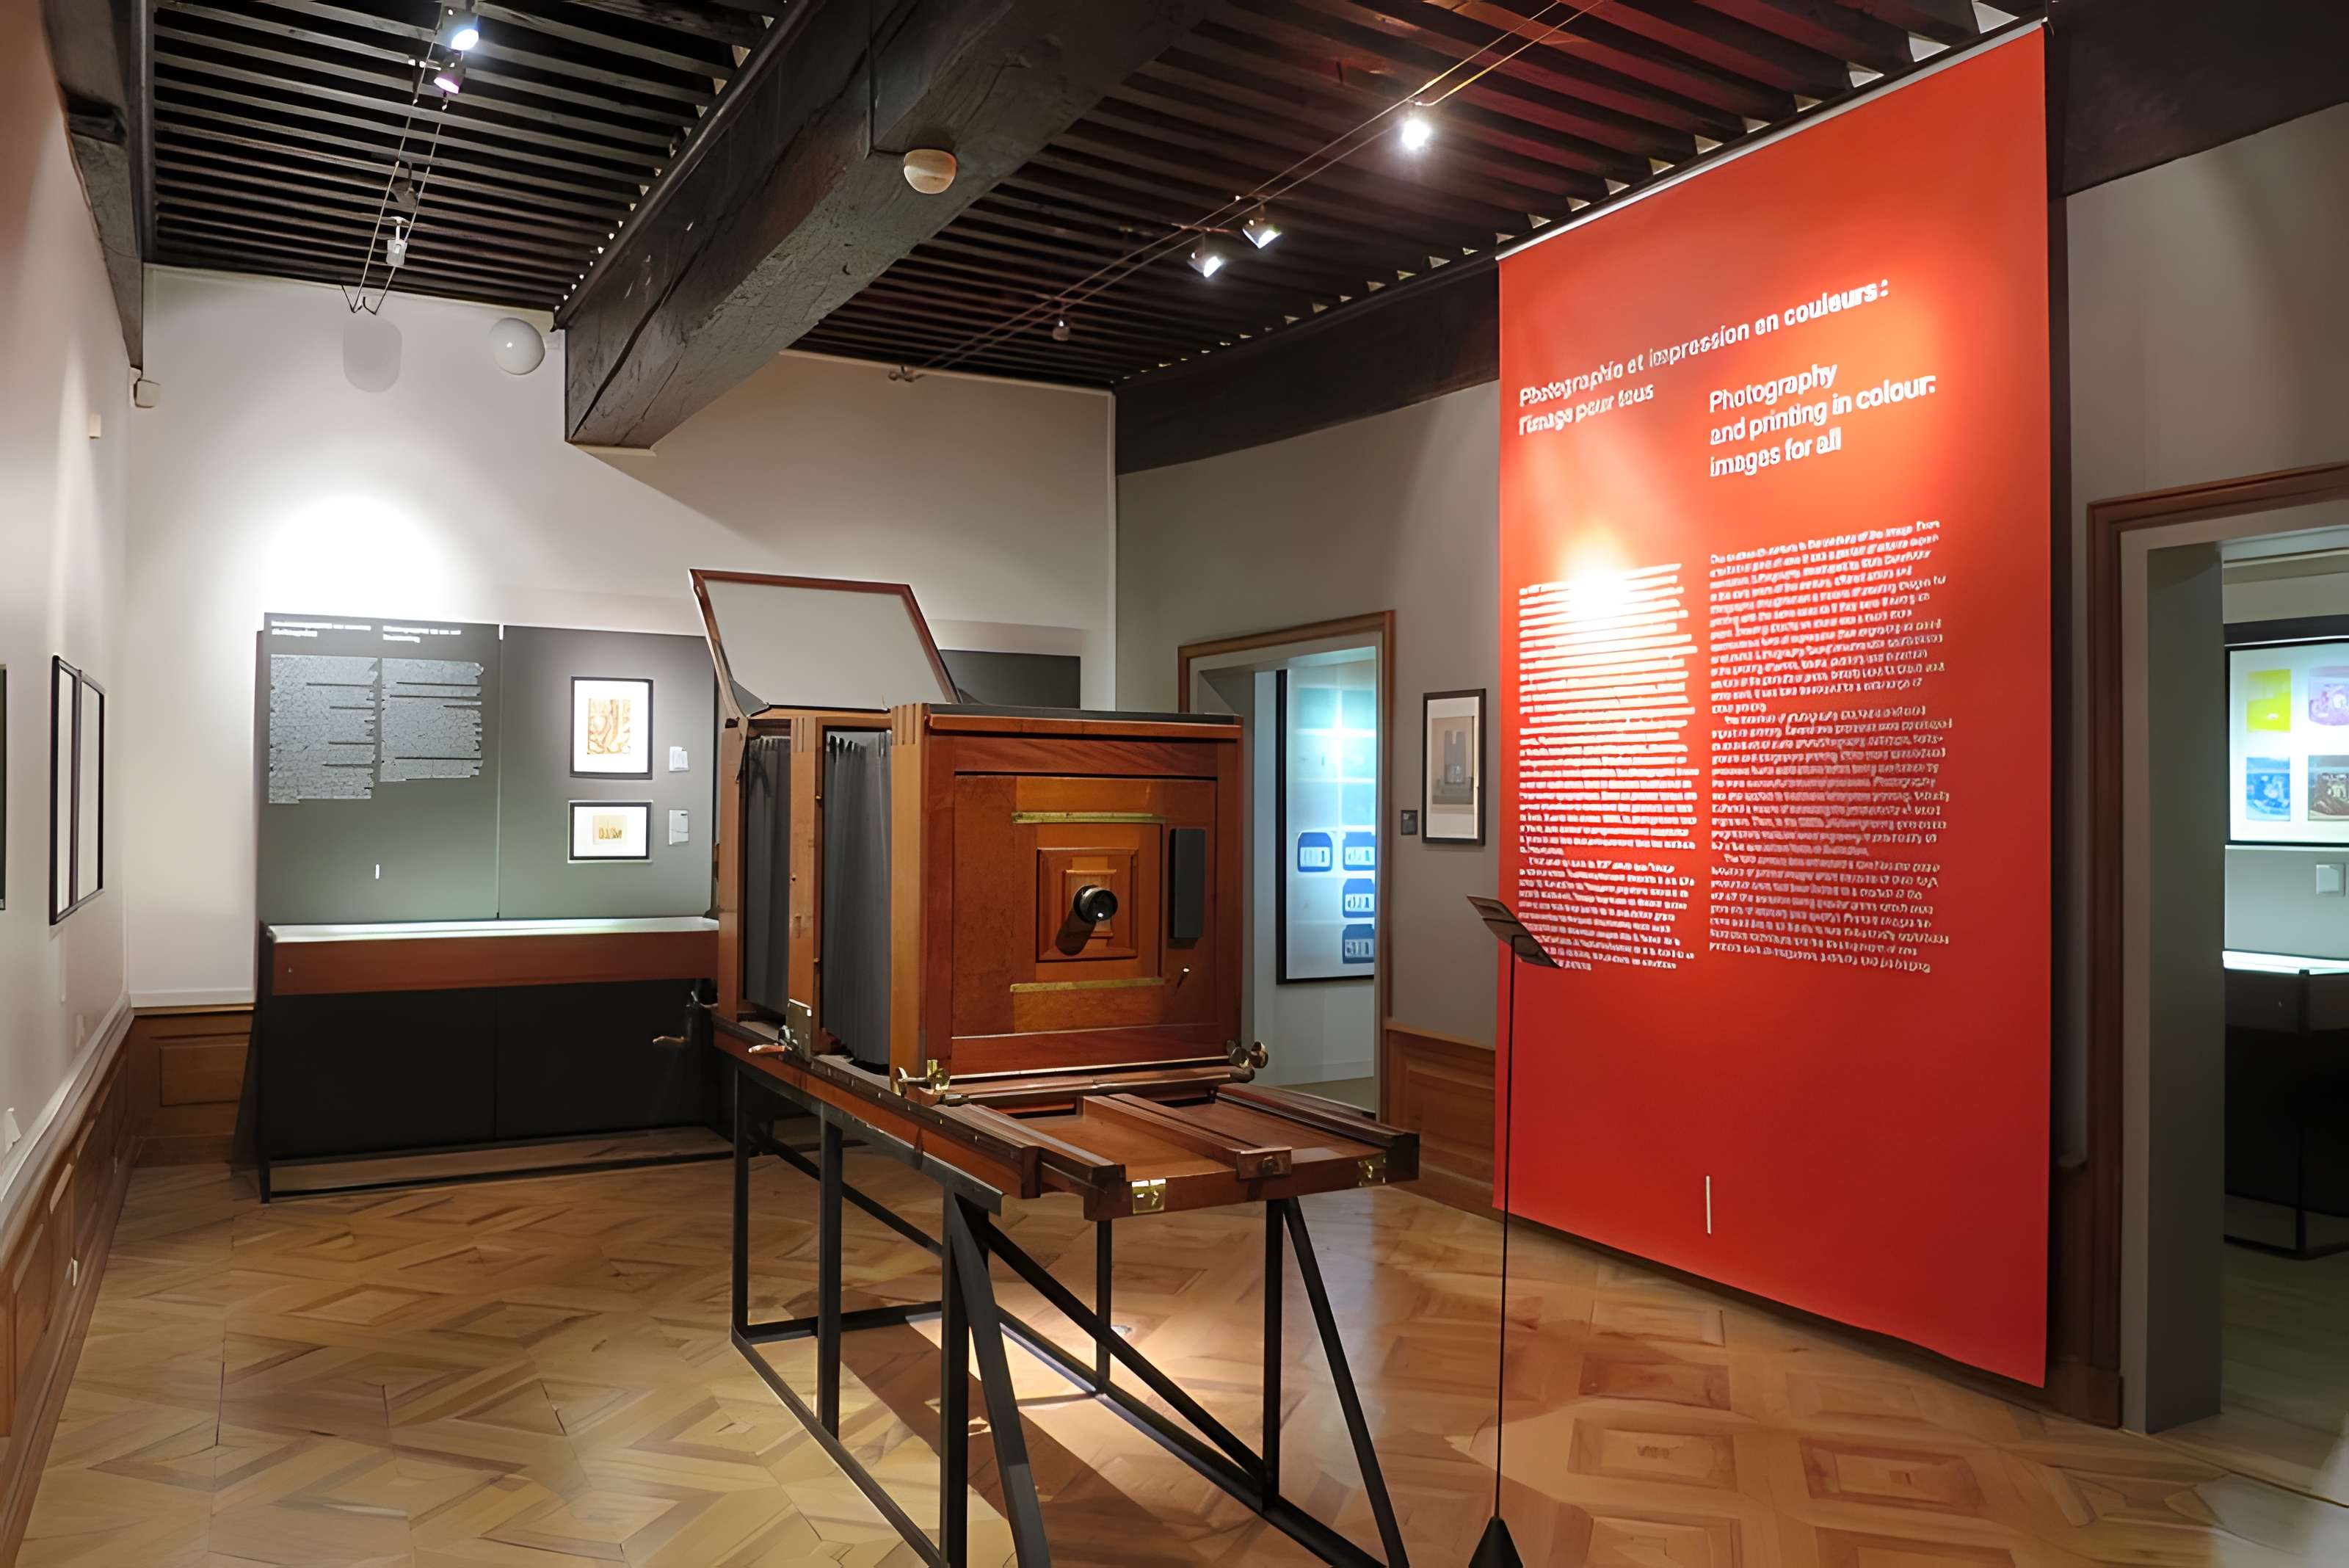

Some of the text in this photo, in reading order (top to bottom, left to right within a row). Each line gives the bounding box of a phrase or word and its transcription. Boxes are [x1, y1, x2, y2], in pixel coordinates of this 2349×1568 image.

[1754, 313, 1779, 335] en
[1709, 363, 1837, 413] Photography
[1710, 416, 1746, 446] and
[1749, 401, 1827, 441] printing
[1832, 393, 1853, 415] in
[1710, 427, 1842, 477] images for all
